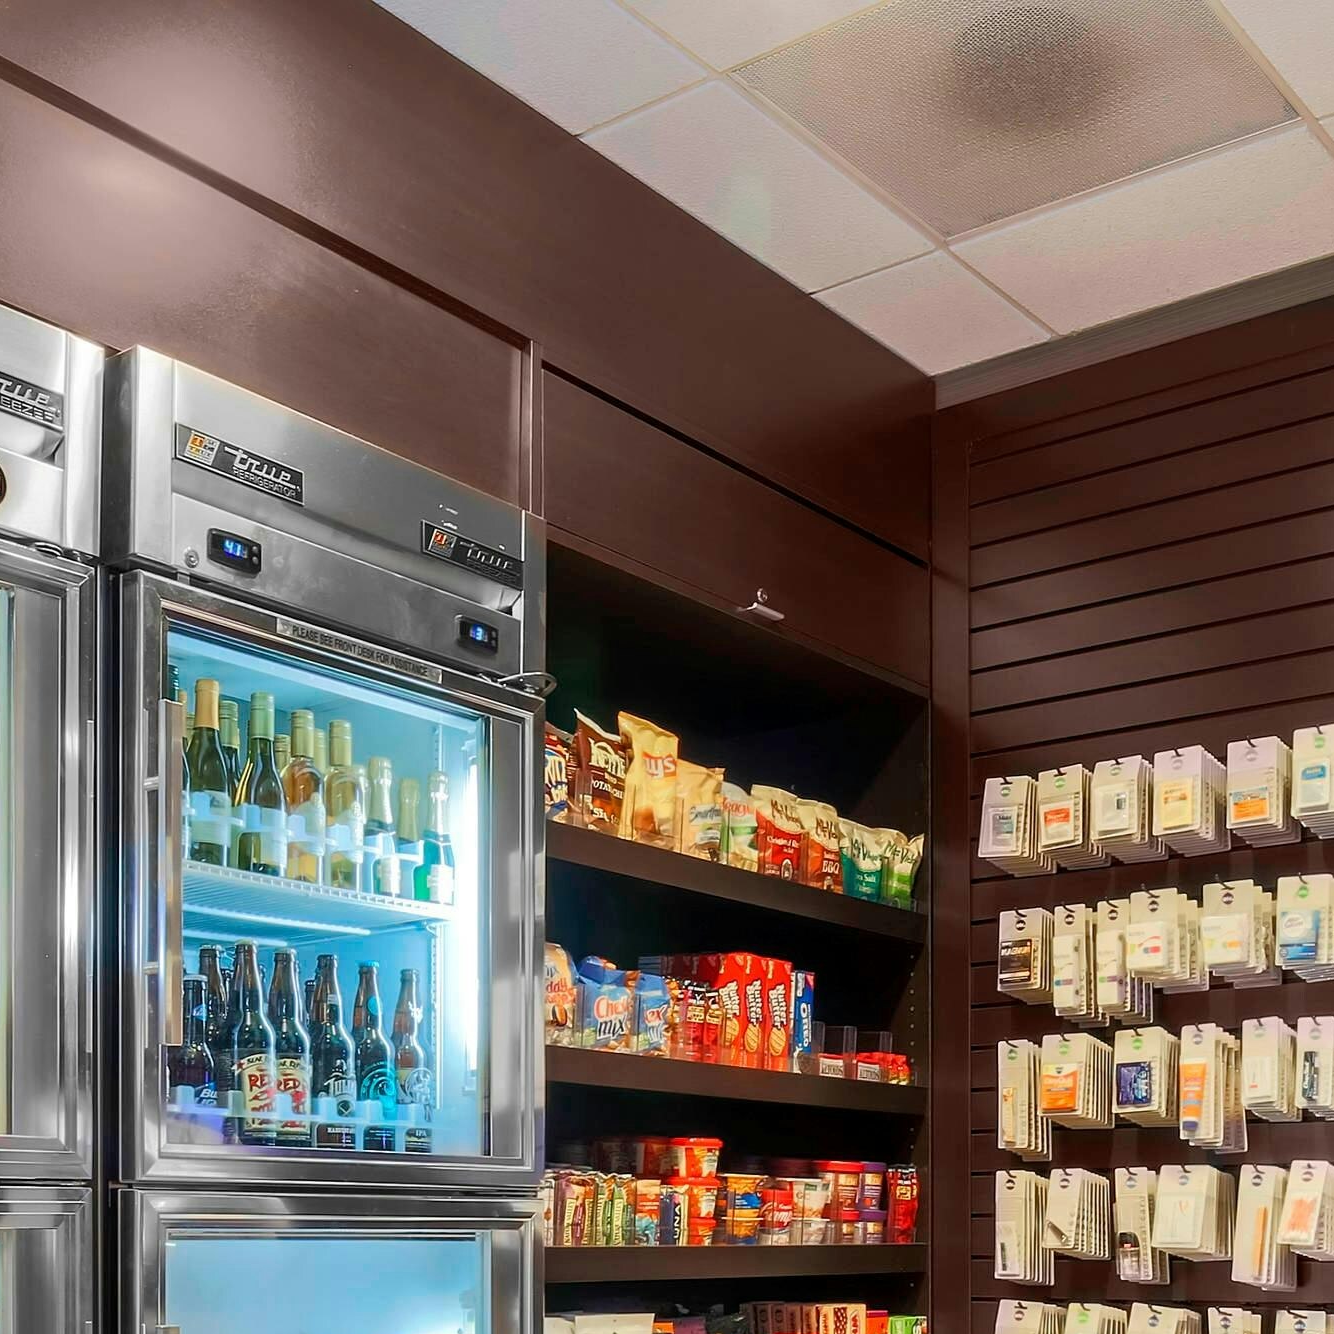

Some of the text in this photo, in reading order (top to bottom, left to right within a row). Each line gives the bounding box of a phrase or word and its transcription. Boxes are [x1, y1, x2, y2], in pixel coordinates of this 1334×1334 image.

[292, 625, 319, 641] PLEASE
[320, 634, 333, 647] SEE
[335, 638, 357, 654] FRONT
[376, 652, 390, 664] FOR
[390, 656, 428, 677] ASSISTANCE
[822, 860, 840, 874] BBQ
